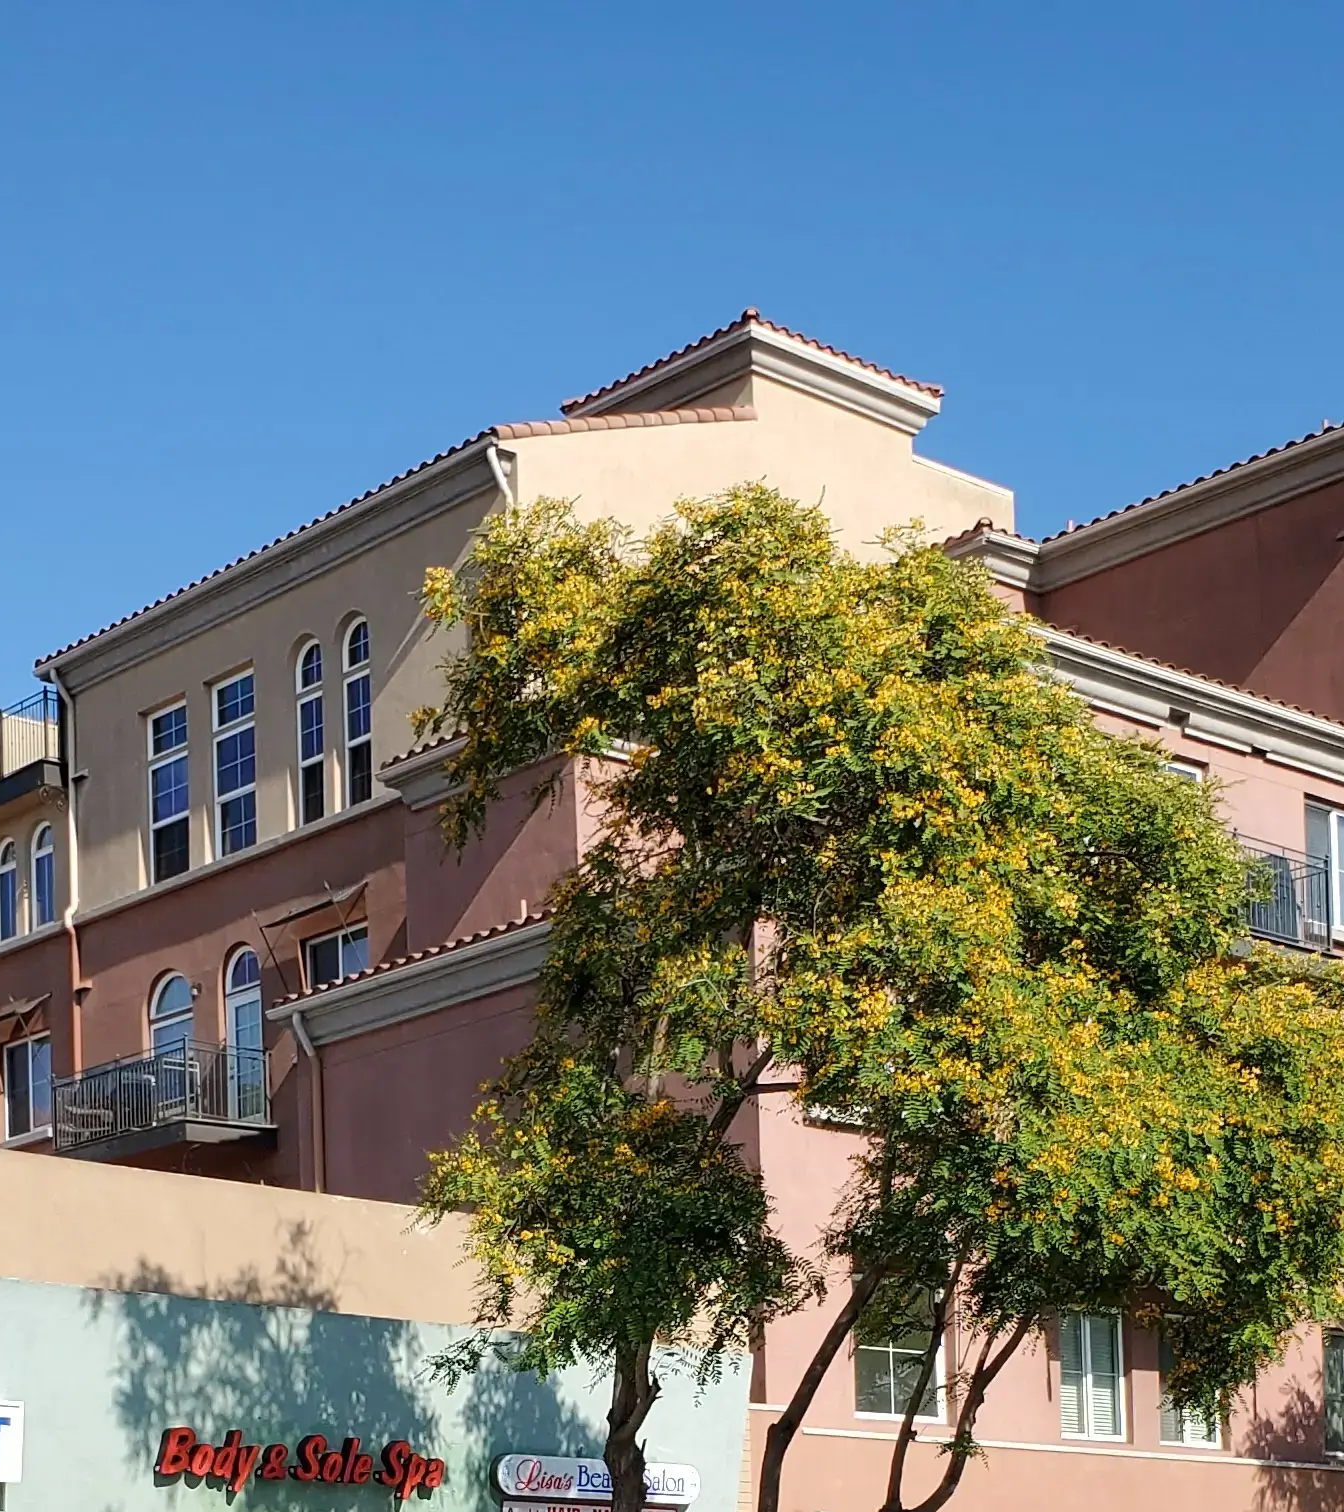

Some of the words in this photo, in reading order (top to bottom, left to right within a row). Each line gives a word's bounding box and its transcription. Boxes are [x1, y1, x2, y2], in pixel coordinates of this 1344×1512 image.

[158, 1427, 260, 1493] Body
[262, 1444, 289, 1480] &
[296, 1434, 373, 1484] Sole
[380, 1440, 444, 1500] Spa
[515, 1458, 574, 1491] Lisa's
[577, 1464, 613, 1489] Bea
[643, 1468, 685, 1492] Salon
